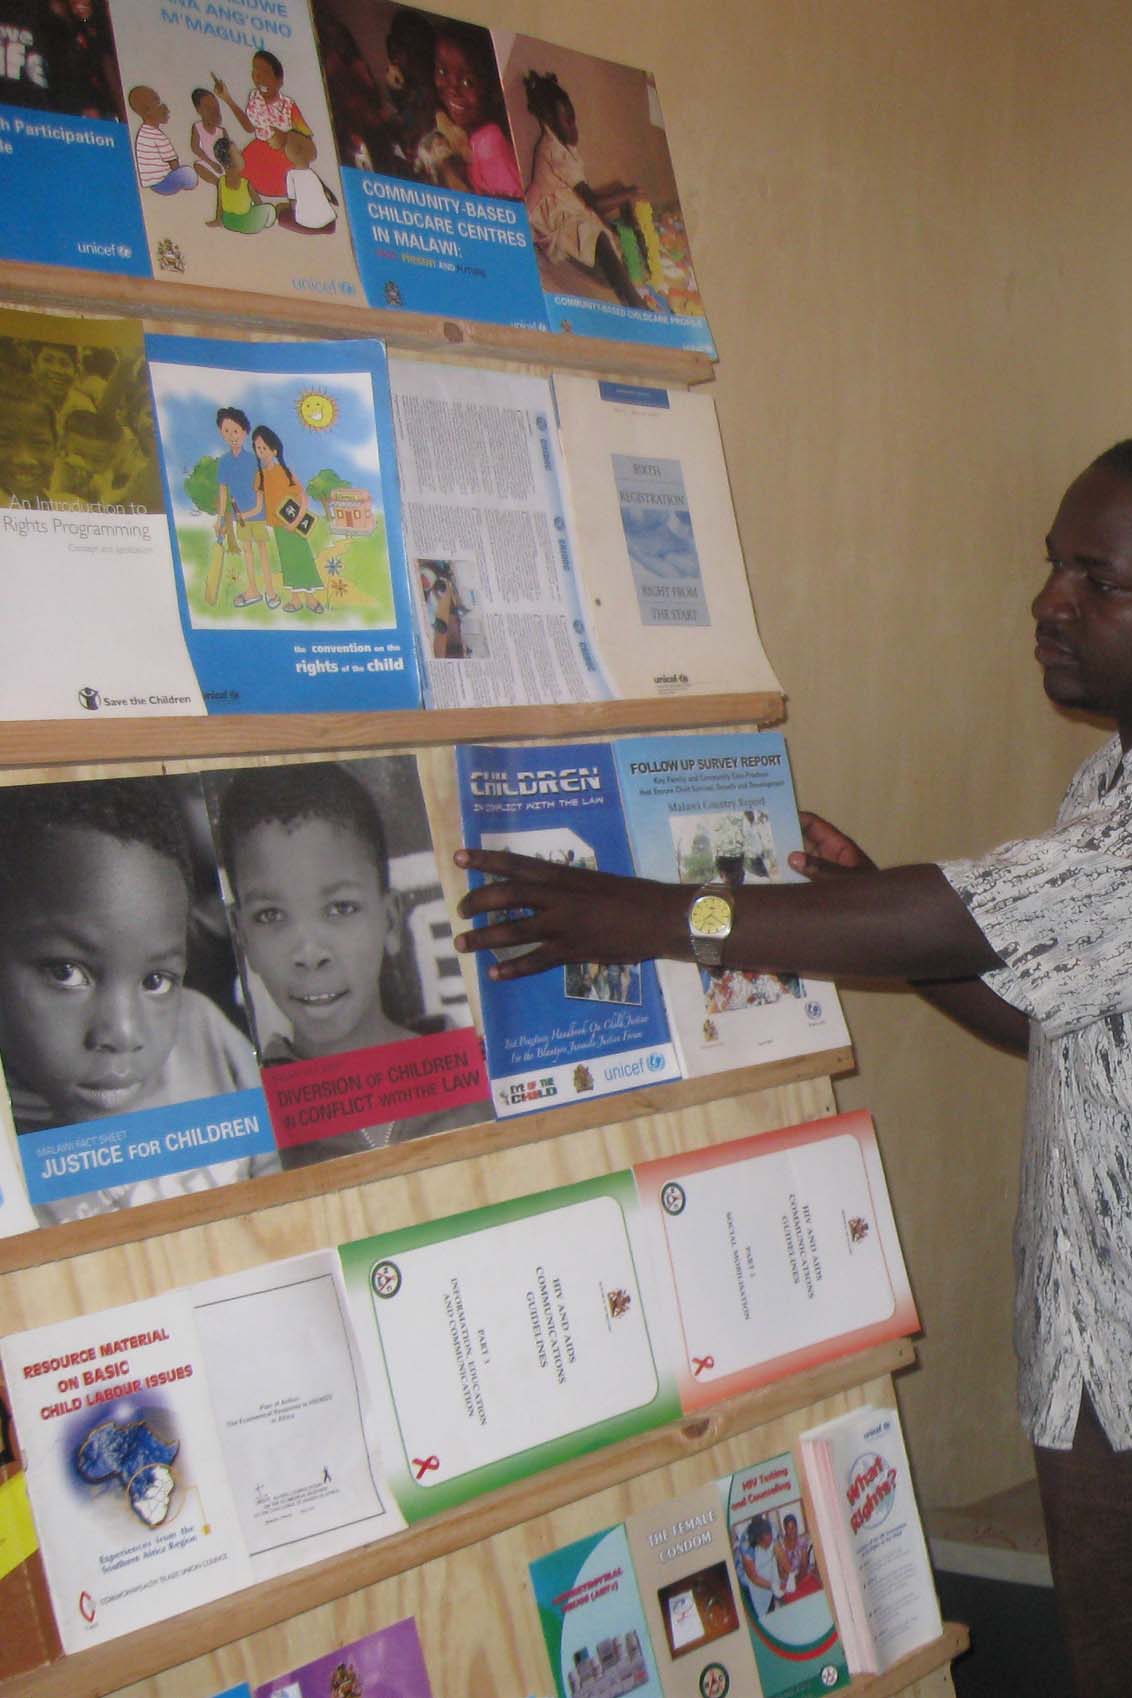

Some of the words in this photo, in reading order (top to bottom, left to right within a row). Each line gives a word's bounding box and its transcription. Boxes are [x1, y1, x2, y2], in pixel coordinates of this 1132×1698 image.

[15, 119, 115, 147] Participation
[363, 180, 516, 224] COMMUNITY-BASED
[368, 203, 454, 234] CHILDCARE
[458, 223, 526, 248] CENTRES
[78, 242, 116, 257] unicef
[372, 226, 390, 243] IN
[394, 231, 463, 258] MALAWI:
[3, 516, 48, 536] Rights
[53, 518, 151, 540] Programming
[312, 642, 371, 653] convention
[296, 660, 338, 676] rights
[367, 657, 404, 672] child
[103, 697, 127, 707] Save
[130, 696, 147, 705] the
[149, 694, 191, 706] Children
[630, 760, 678, 775] FOLLOW
[680, 759, 695, 771] UP
[698, 756, 738, 770] SURVEY
[741, 754, 781, 768] REPORT
[471, 767, 601, 796] CHILDREN
[526, 800, 555, 810] WITH
[559, 798, 578, 808] THE
[277, 1074, 363, 1107] DIVERSION
[366, 1071, 384, 1088] OF
[387, 1051, 469, 1083] CHILDREN
[604, 1058, 644, 1081] unicef
[299, 1094, 374, 1125] CONFLICT
[379, 1089, 412, 1109] WITH
[415, 1084, 438, 1100] THE
[442, 1072, 480, 1093] LAW
[41, 1145, 124, 1179] JUSTICE
[128, 1140, 161, 1160] FOR
[165, 1115, 259, 1151] CHILDREN
[99, 1130, 127, 1143] SHEET
[527, 1291, 547, 1368] GUIDELINES
[536, 1266, 566, 1384] COMMUNICATIONS
[553, 1278, 562, 1299] HIV
[558, 1304, 569, 1331] AND
[564, 1335, 576, 1364] AIDS
[23, 1347, 97, 1379] RESOURCE
[99, 1327, 170, 1358] MATERIAL
[478, 1328, 489, 1355] PART
[57, 1375, 80, 1393] ON
[82, 1360, 131, 1386] BASIC
[449, 1319, 474, 1418] COMMUNICATION
[40, 1397, 82, 1421] CHILD
[86, 1379, 142, 1407] LABOUR
[145, 1364, 193, 1389] ISSUES
[468, 1361, 488, 1426] EDUCATION
[181, 1525, 195, 1536] the
[648, 1532, 668, 1547] THE
[672, 1511, 714, 1535] FEMALE
[659, 1531, 712, 1562] CONDOM
